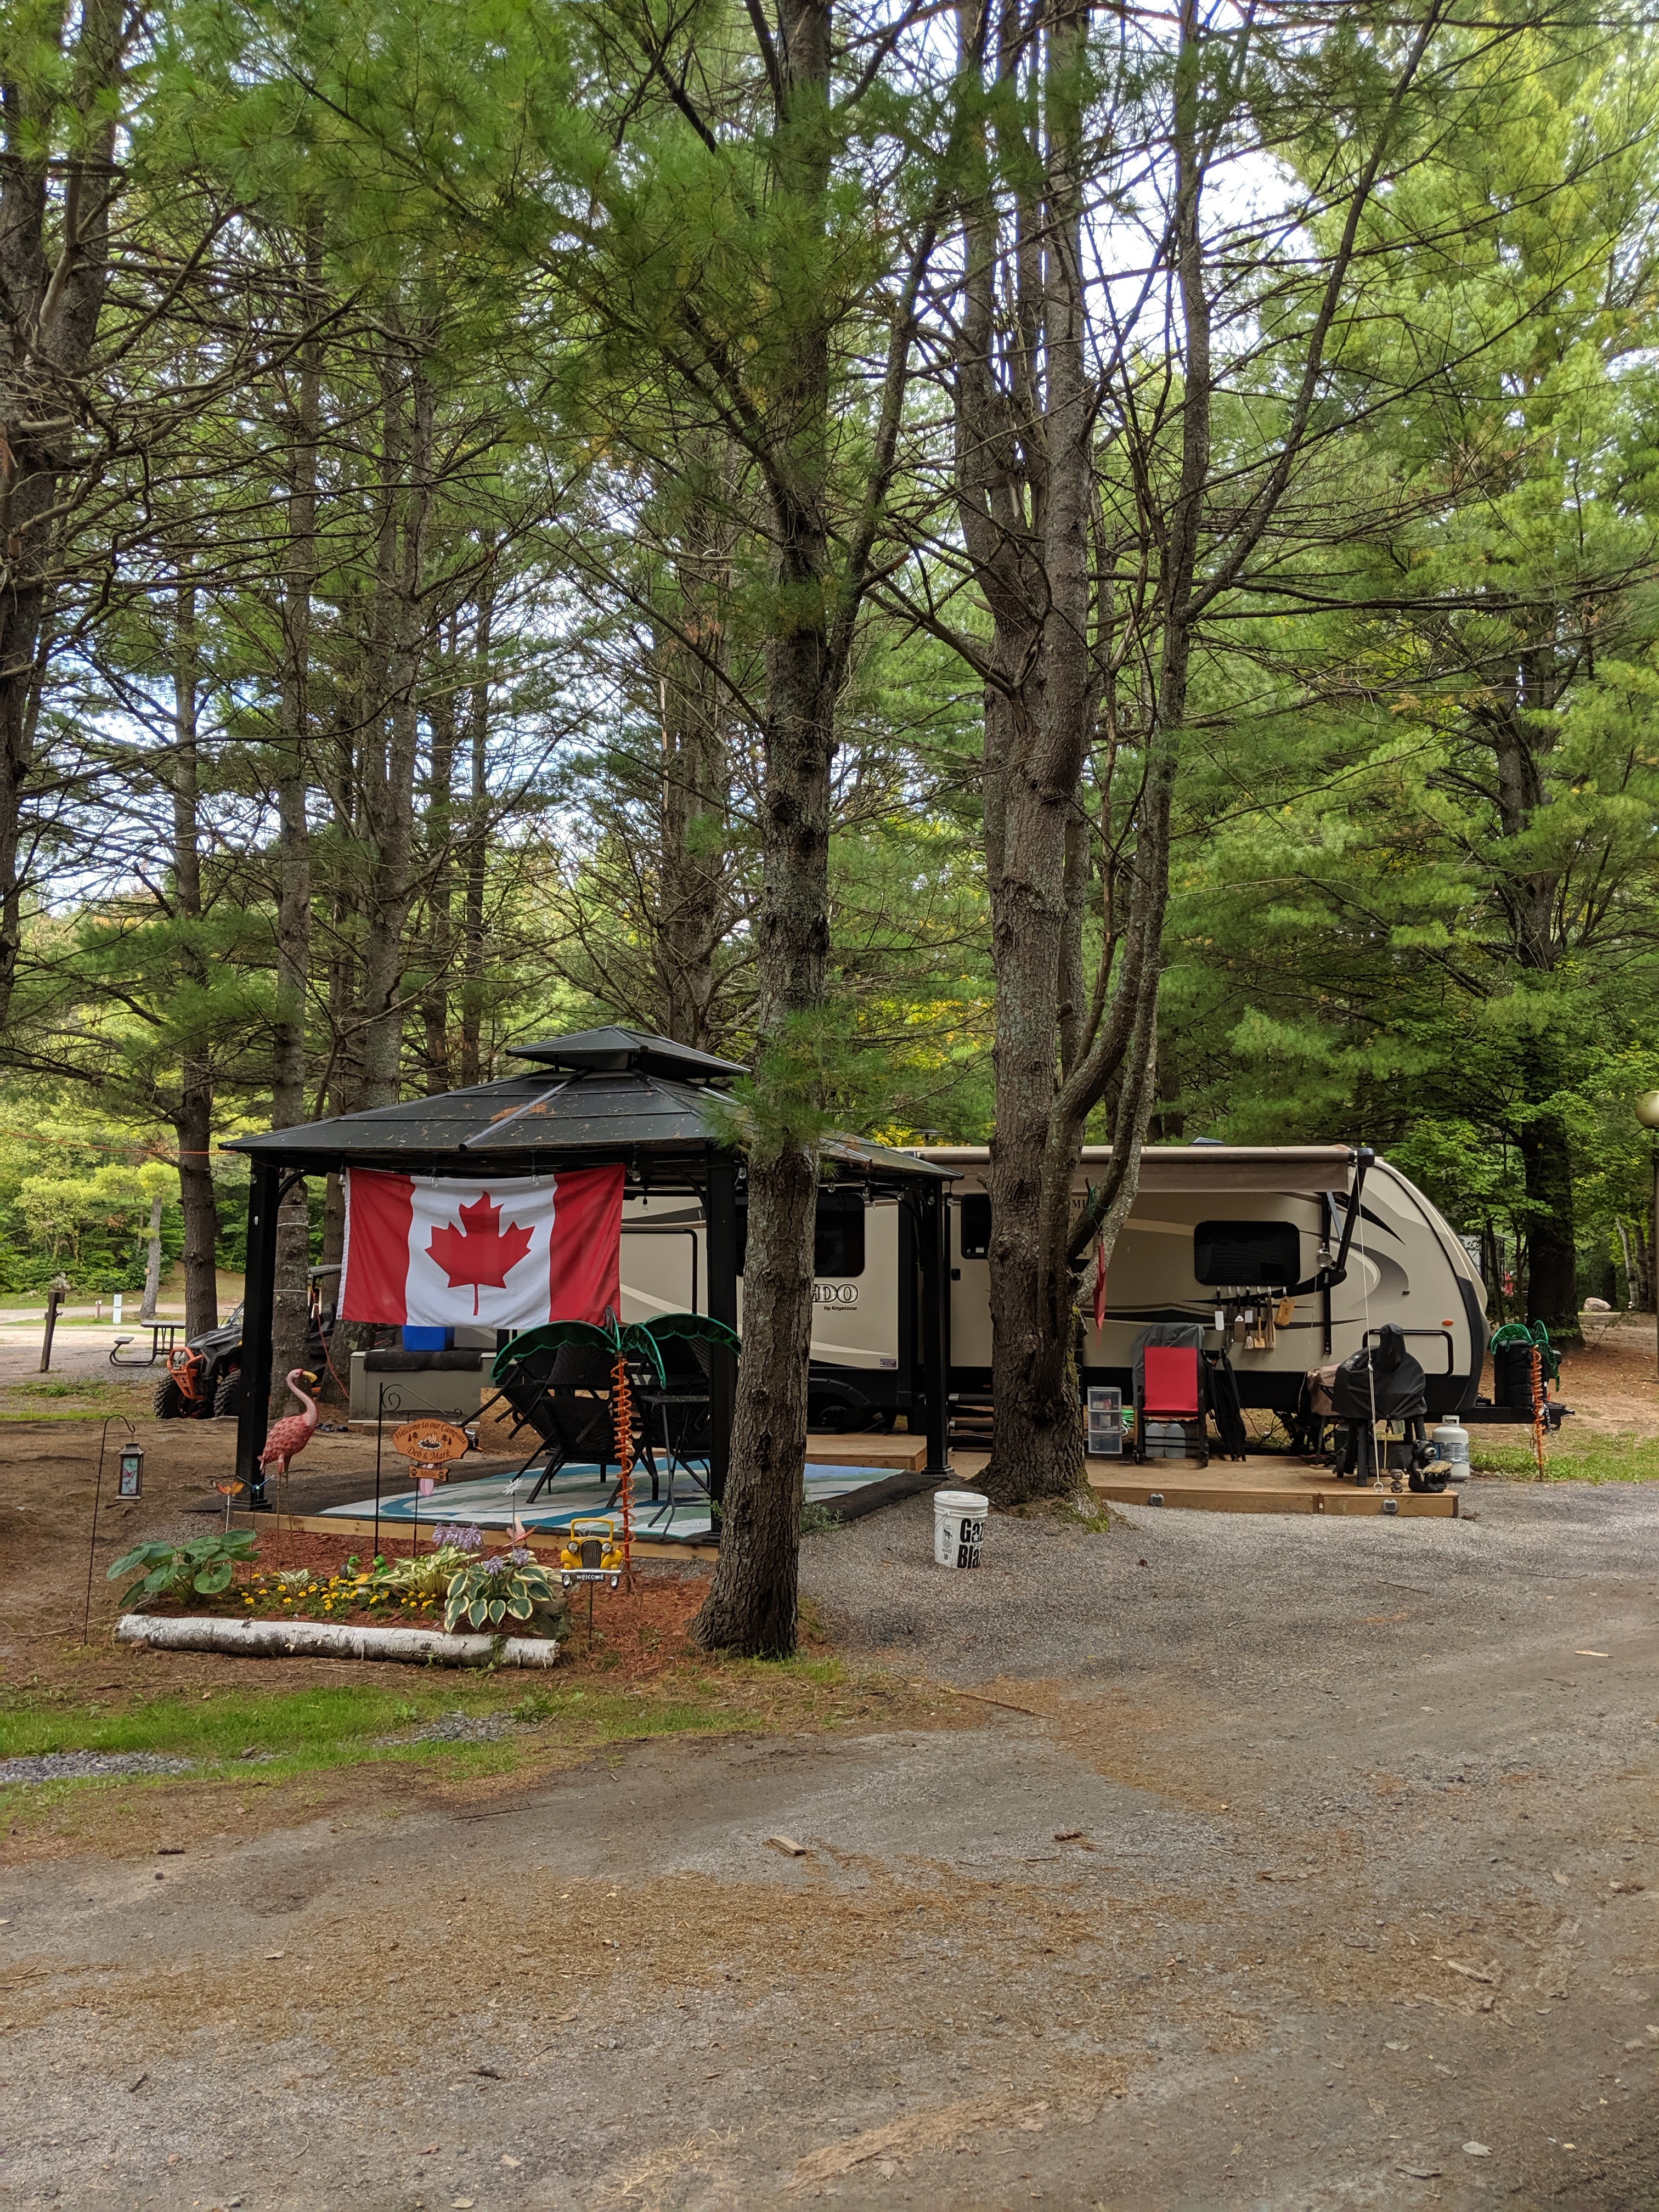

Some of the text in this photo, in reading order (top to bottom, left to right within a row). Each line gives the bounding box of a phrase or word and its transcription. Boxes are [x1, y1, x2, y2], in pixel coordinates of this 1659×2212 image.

[396, 1423, 421, 1440] Welcome
[441, 1423, 467, 1445] Campsite
[407, 1447, 422, 1458] Deb
[430, 1449, 453, 1460] Mark
